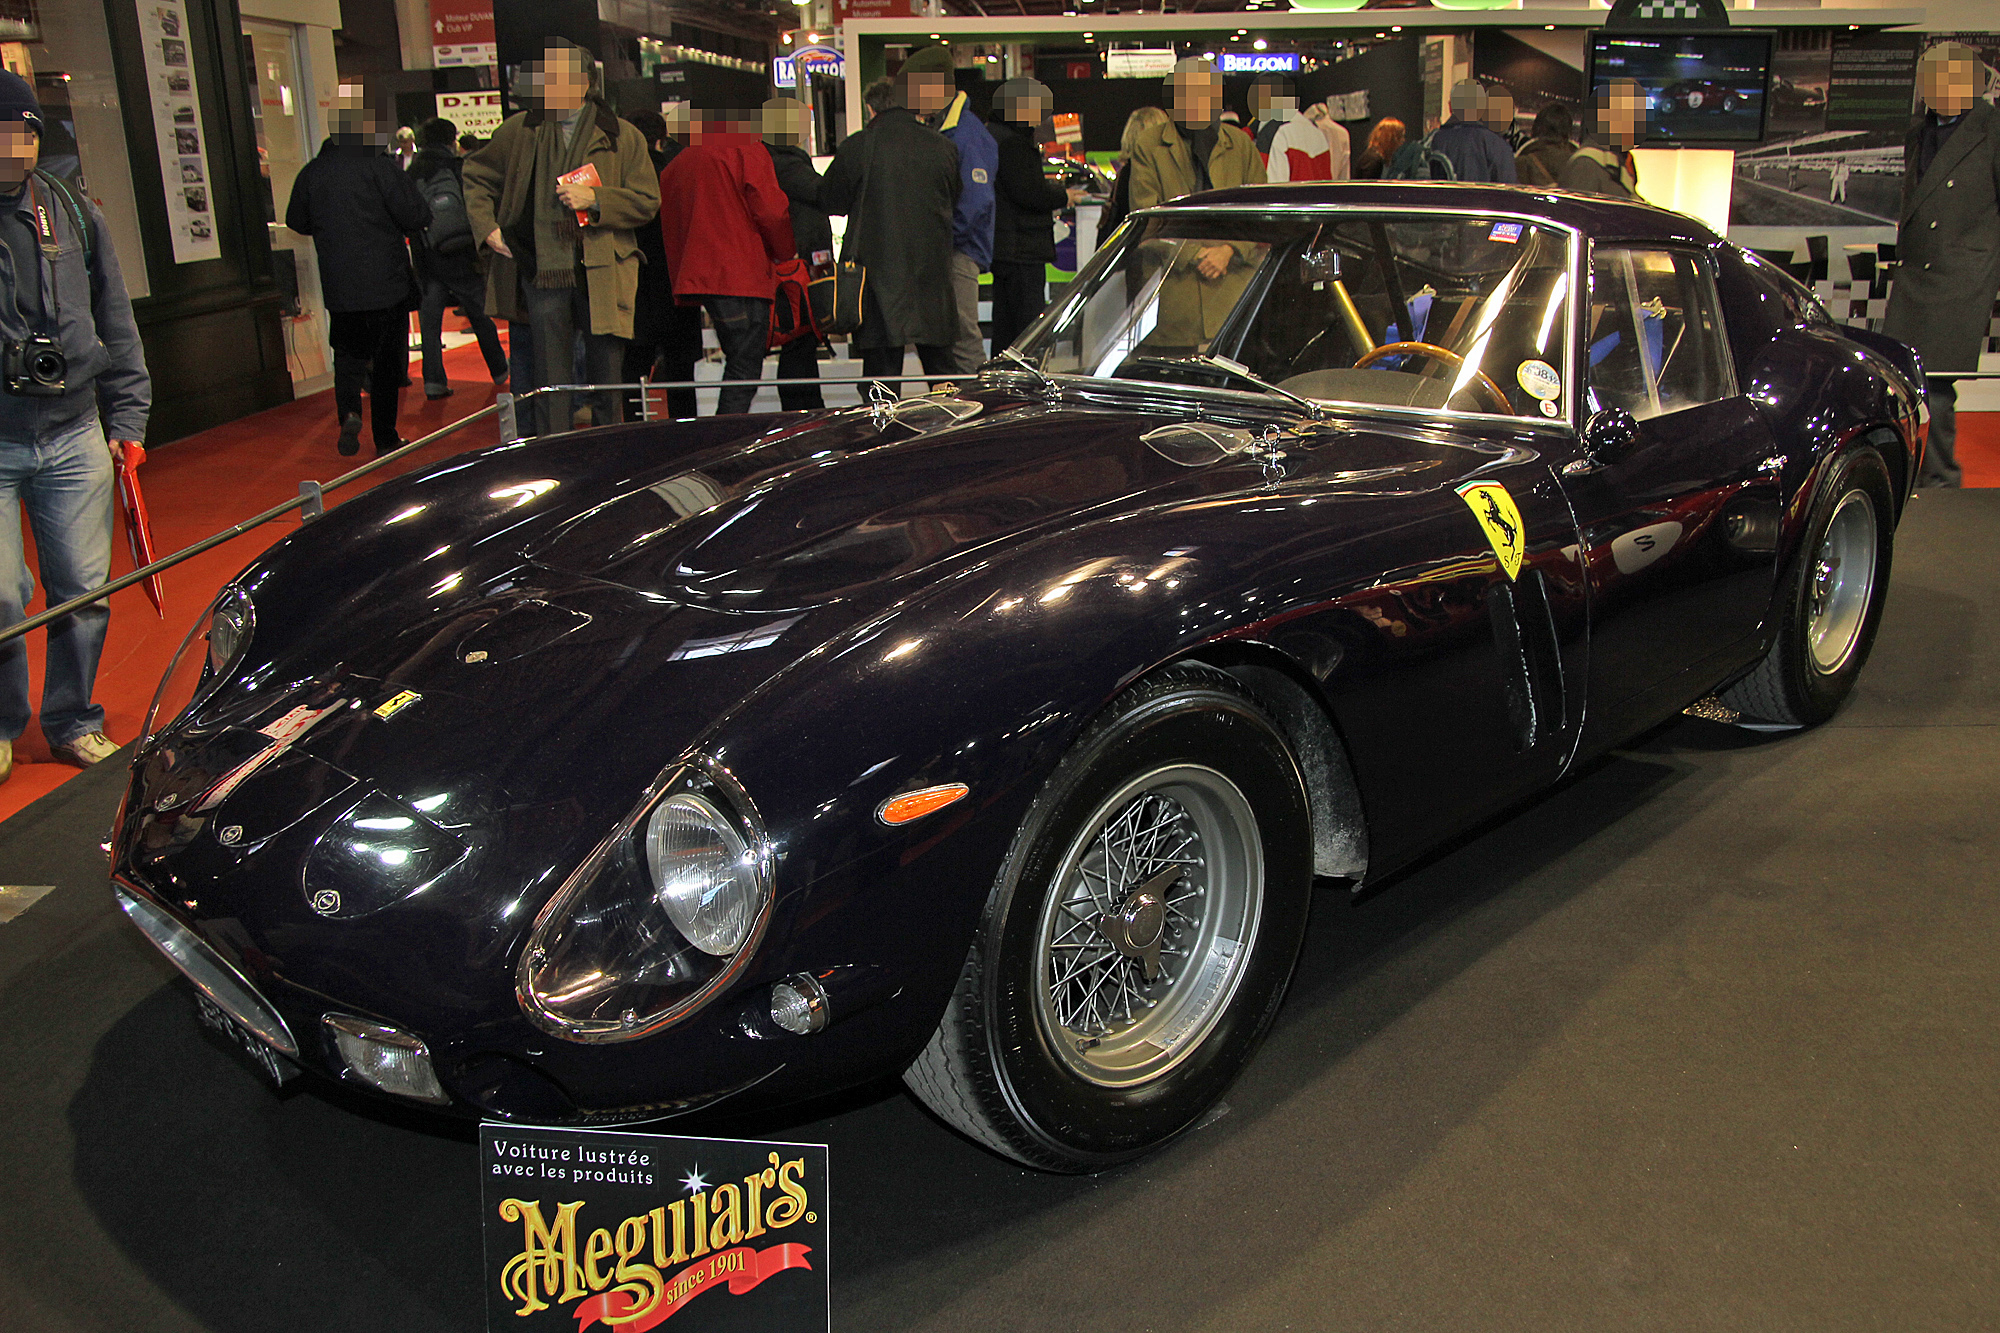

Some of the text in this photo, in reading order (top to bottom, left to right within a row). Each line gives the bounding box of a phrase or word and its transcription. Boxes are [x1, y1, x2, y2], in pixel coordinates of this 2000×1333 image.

[1223, 54, 1293, 72] BELGOM
[37, 204, 51, 237] Canon
[1544, 402, 1554, 415] E
[493, 1140, 651, 1167] Voiture lustrée
[492, 1162, 654, 1186] avec les produits
[498, 1151, 809, 1327] Meguiar's
[665, 1250, 747, 1306] since 1901
